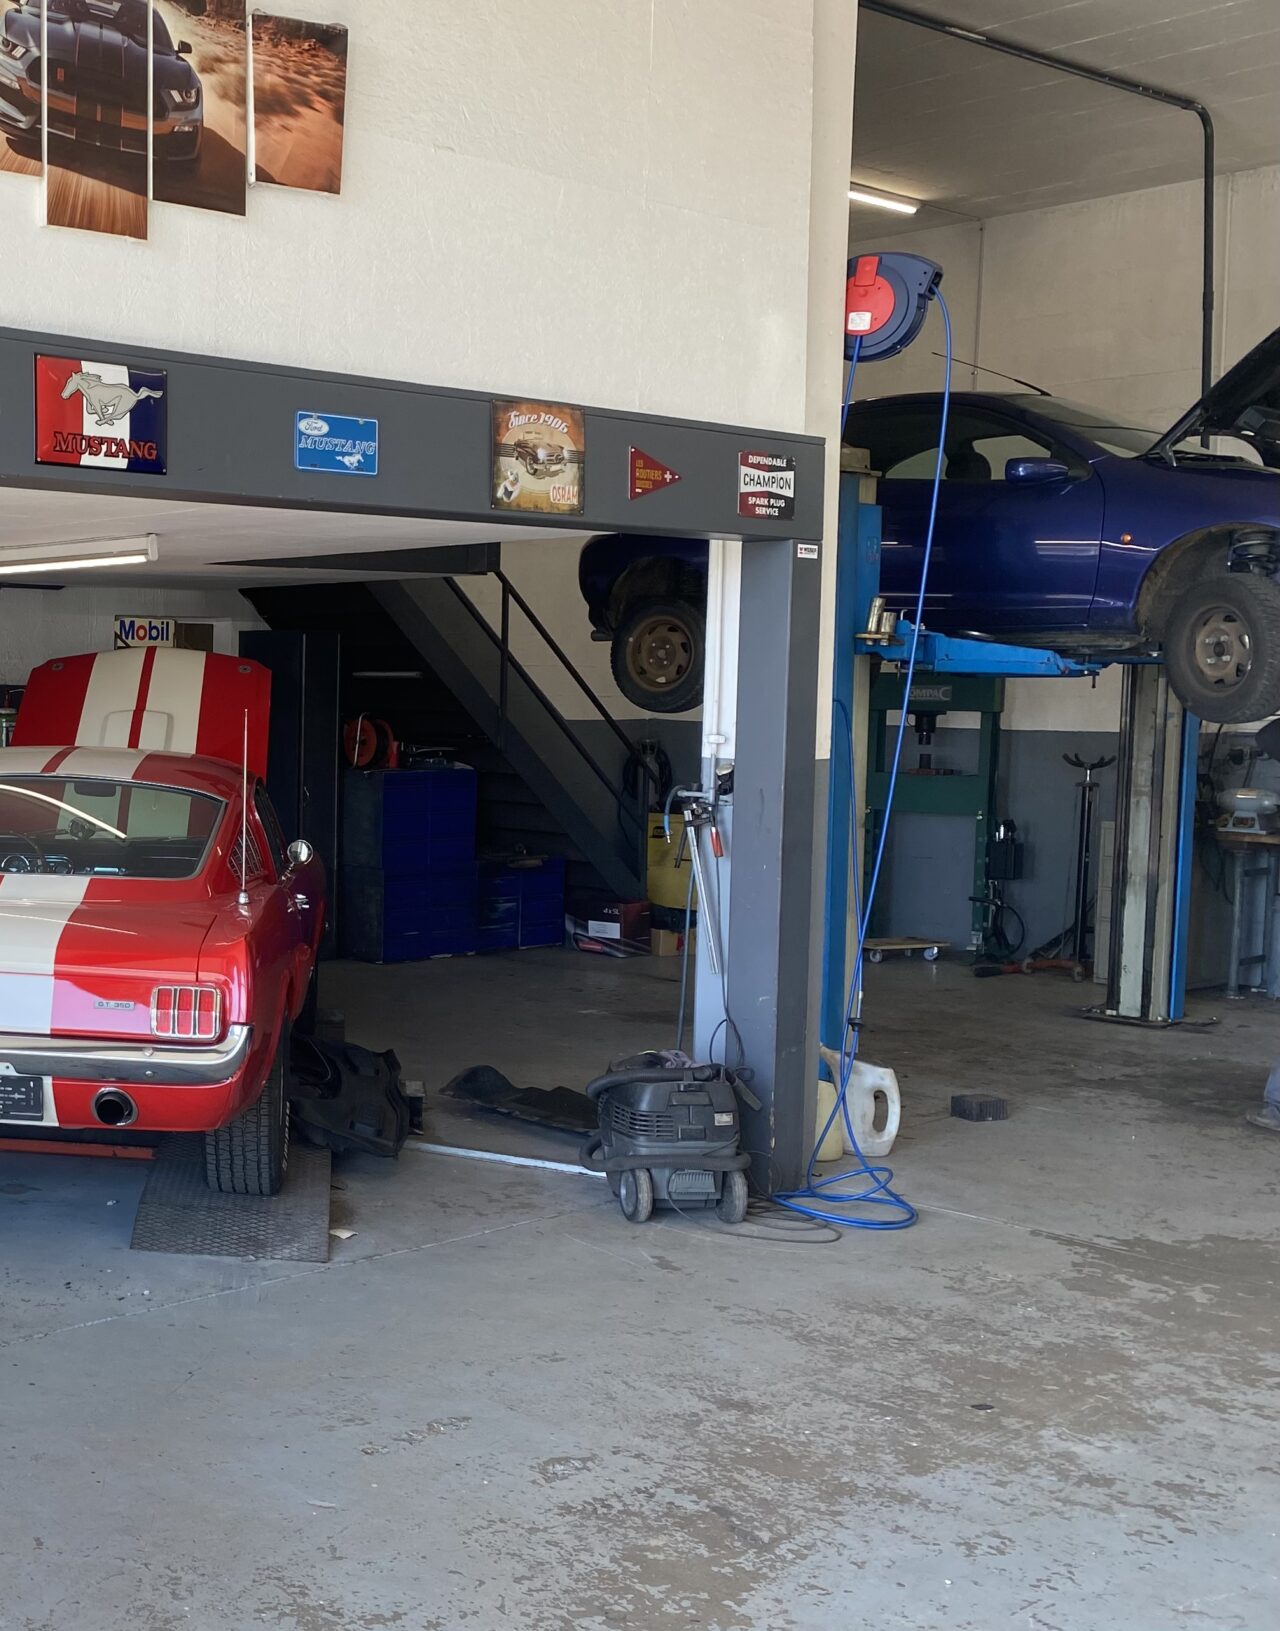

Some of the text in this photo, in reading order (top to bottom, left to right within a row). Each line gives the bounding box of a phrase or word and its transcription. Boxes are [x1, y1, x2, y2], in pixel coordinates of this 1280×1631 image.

[538, 412, 570, 433] 1906
[53, 431, 158, 460] MUSTANG
[298, 435, 376, 455] MUSTANG
[748, 454, 787, 468] DEPENDABLE
[743, 472, 792, 491] CHAMPION
[551, 485, 578, 503] OSRAM
[748, 496, 786, 508] SPARK PLUG
[755, 506, 779, 516] SERVICE
[120, 619, 170, 641] Mobil
[909, 686, 952, 700] OMPAC
